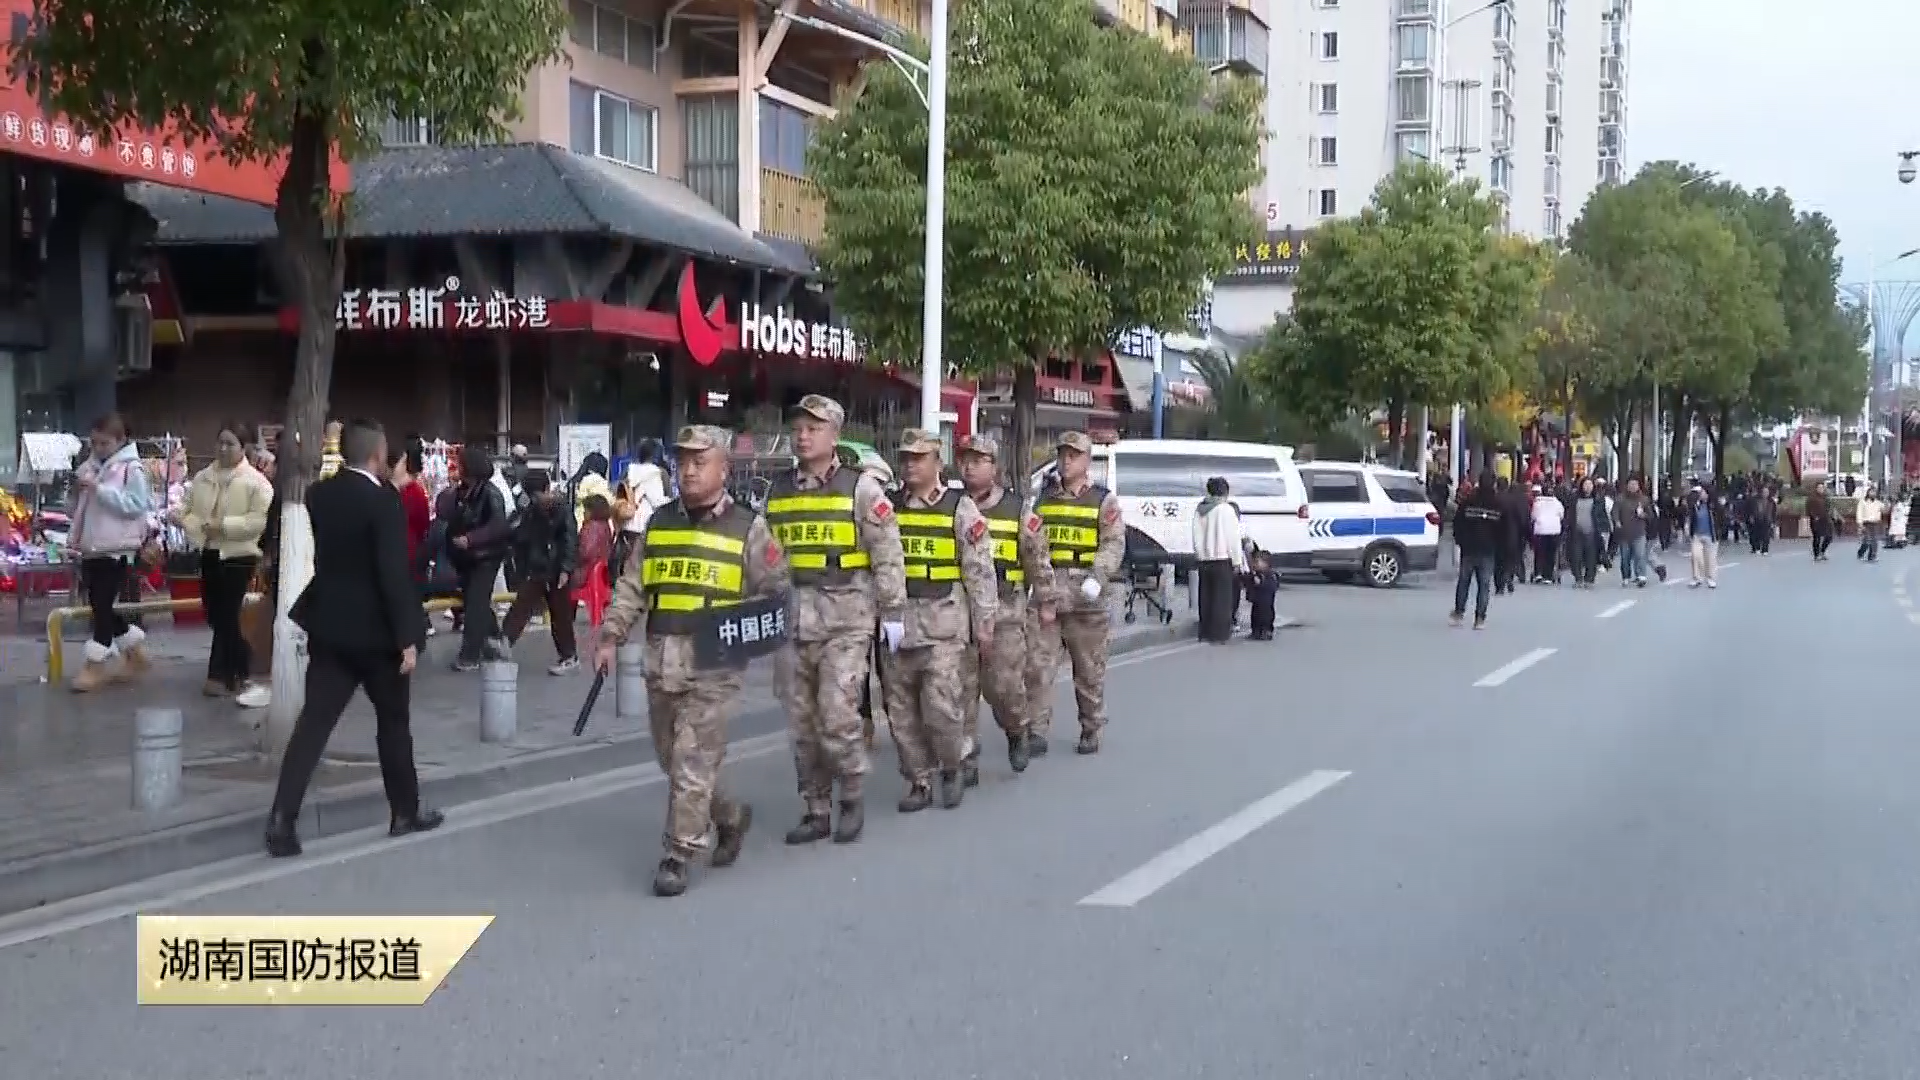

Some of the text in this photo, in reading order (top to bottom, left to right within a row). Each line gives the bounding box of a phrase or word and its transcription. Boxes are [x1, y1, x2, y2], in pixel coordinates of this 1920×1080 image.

[1267, 203, 1277, 220] 5
[454, 289, 550, 330] 龙虾港
[741, 301, 806, 356] Hobs
[1140, 501, 1179, 518] 公安
[776, 522, 837, 542] 中国民兵
[654, 559, 721, 585] 中国民兵
